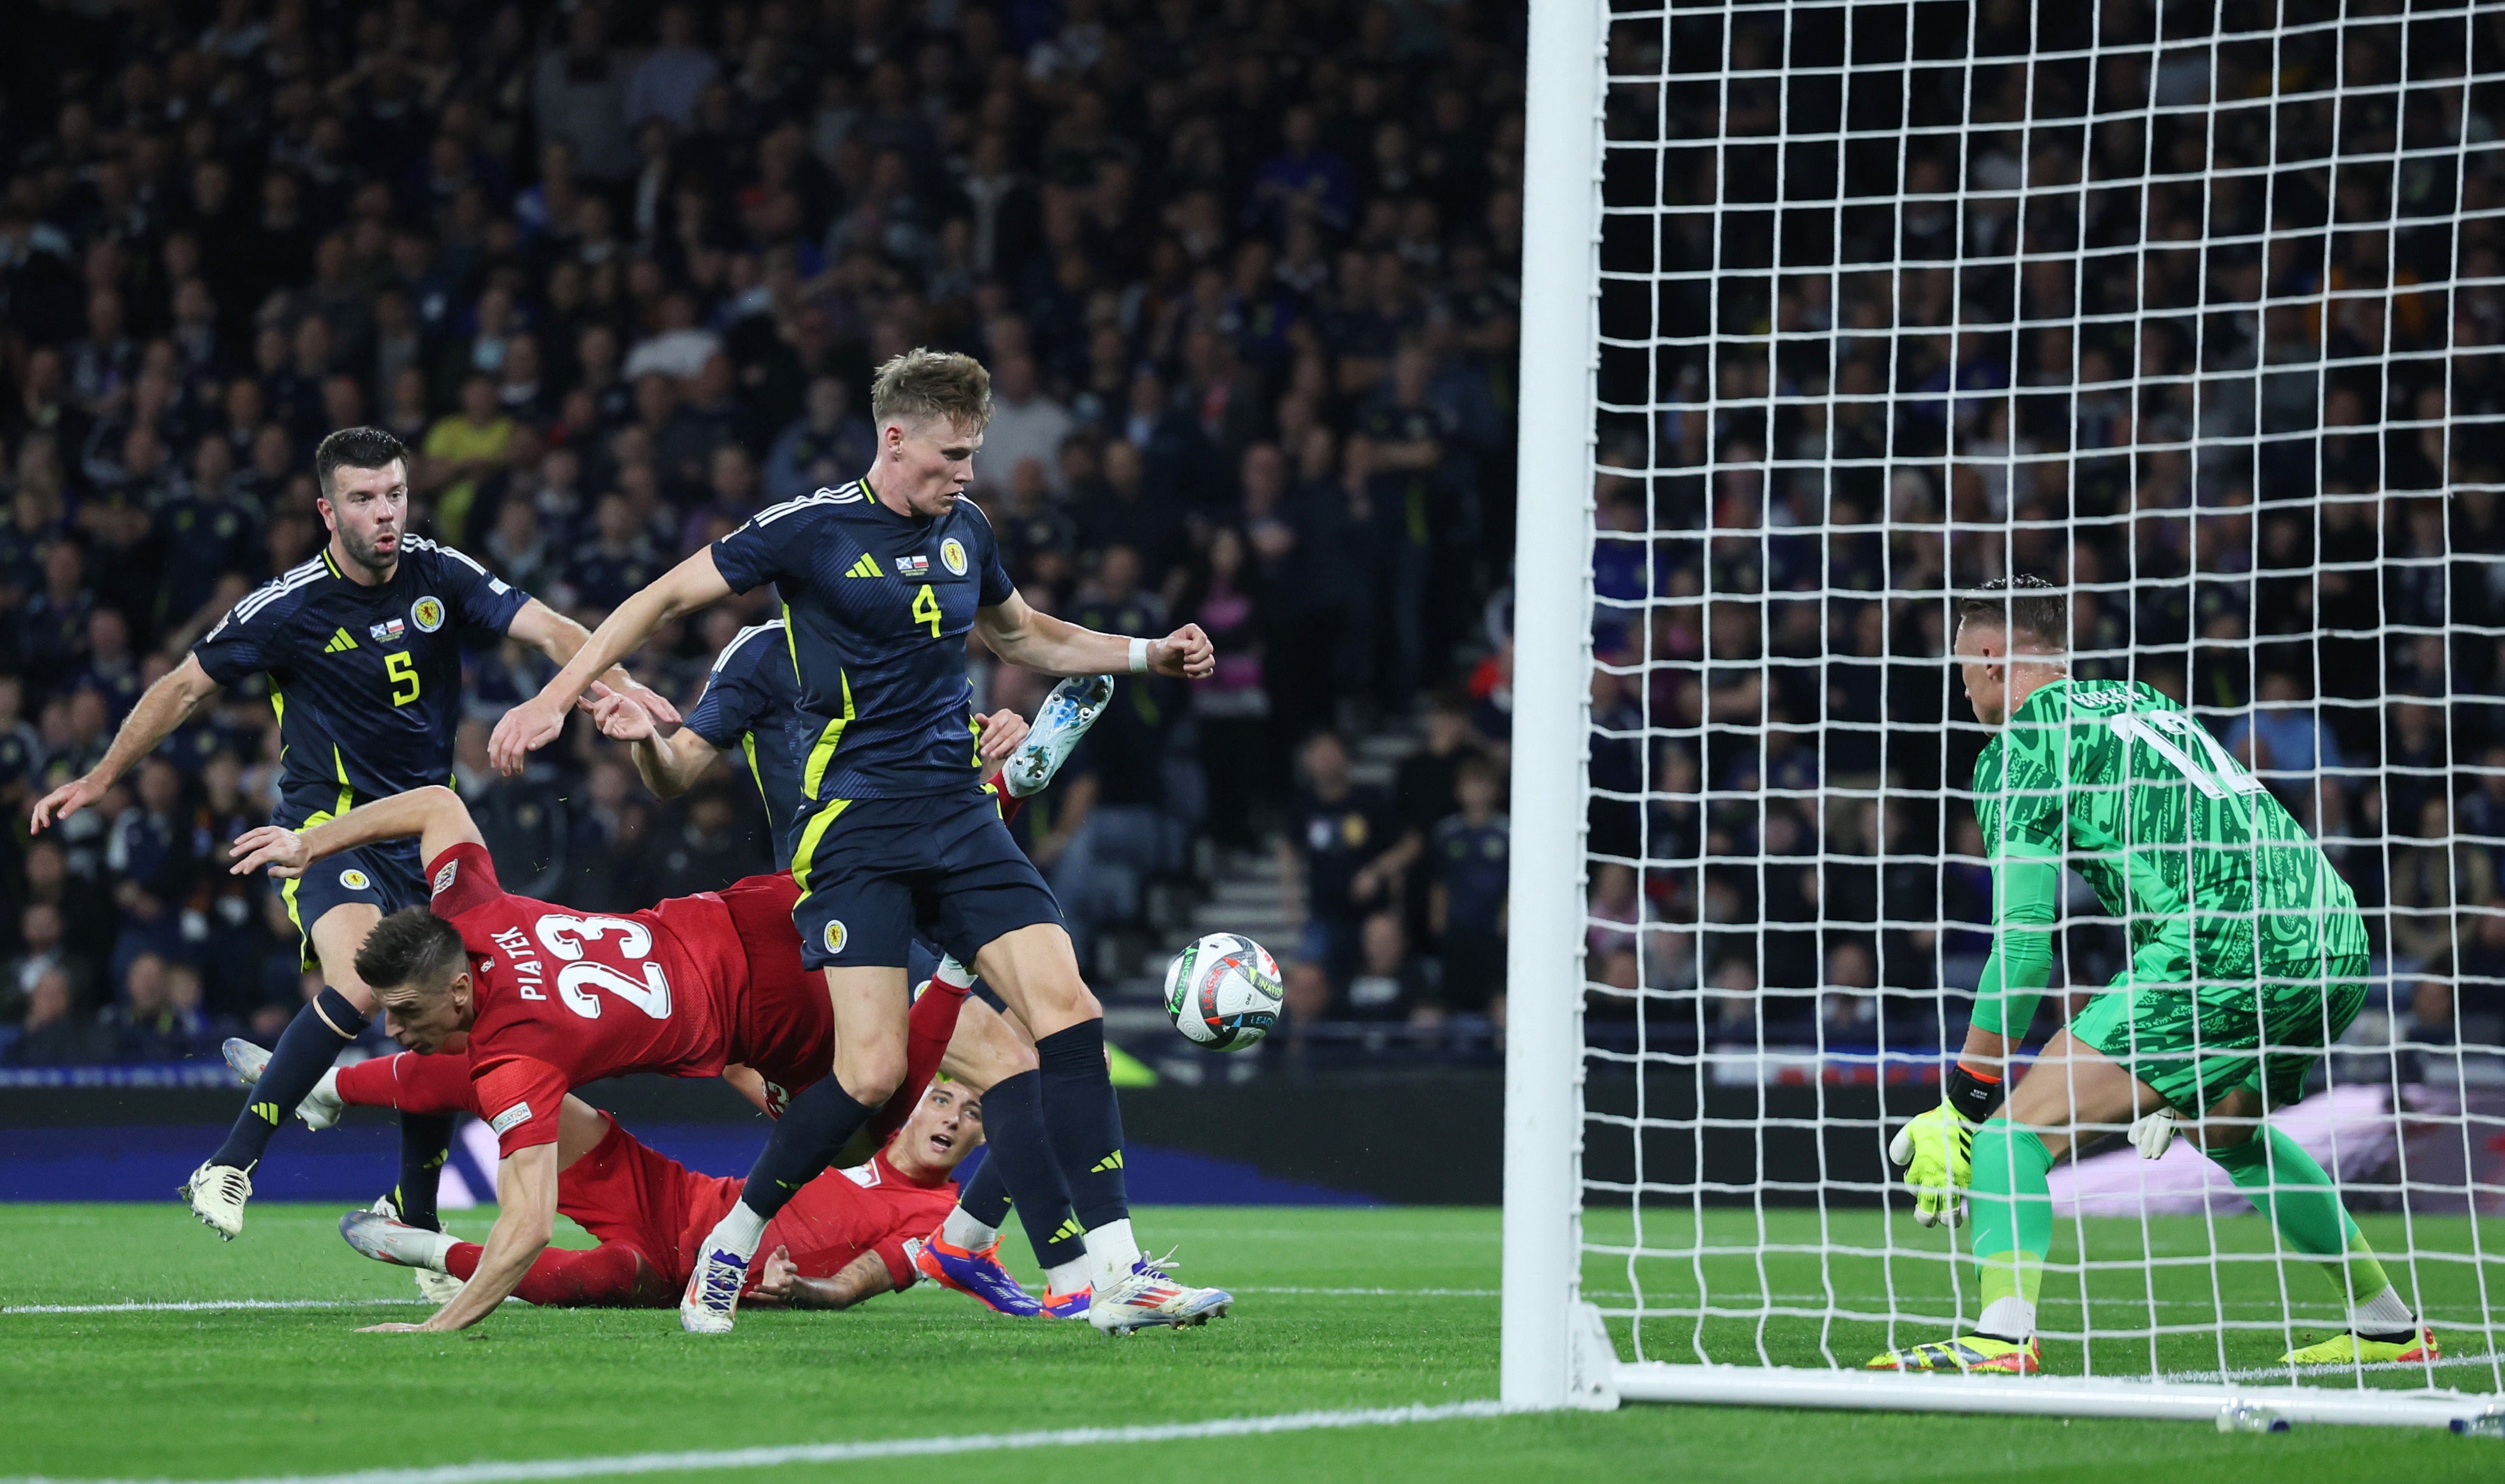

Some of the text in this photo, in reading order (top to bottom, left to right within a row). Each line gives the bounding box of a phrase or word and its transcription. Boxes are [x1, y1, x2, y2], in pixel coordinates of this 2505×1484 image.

[912, 584, 942, 638] 4
[384, 650, 420, 707] 5
[2110, 710, 2268, 800] 12
[490, 925, 547, 1000] PIĄTEK
[535, 914, 672, 1019] 23
[1203, 967, 1223, 1009] LEAGUE
